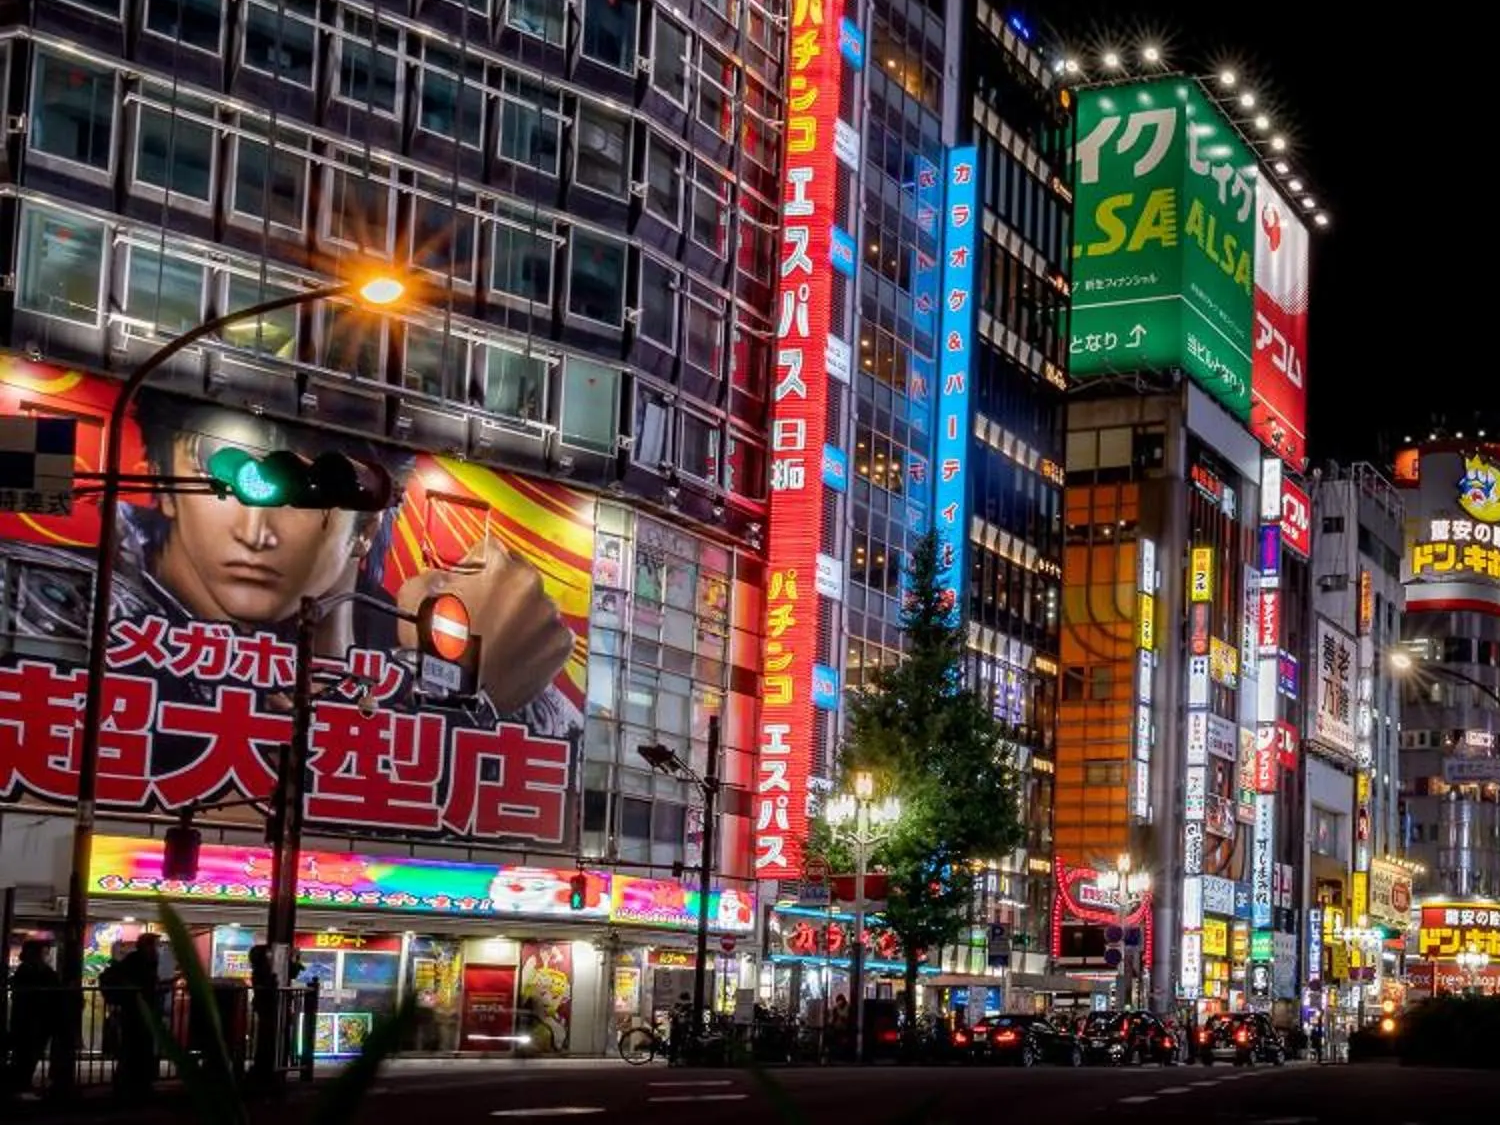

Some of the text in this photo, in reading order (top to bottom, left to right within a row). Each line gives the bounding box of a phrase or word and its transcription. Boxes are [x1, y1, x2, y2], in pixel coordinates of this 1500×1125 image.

[1072, 188, 1179, 259] SA
[1184, 197, 1254, 296] ALSA
[1069, 331, 1118, 355] となり
[1256, 309, 1303, 390] アコム
[105, 614, 406, 702] メガホール
[0, 661, 571, 843] 超大型店
[756, 569, 799, 869] パチンコ エスパス
